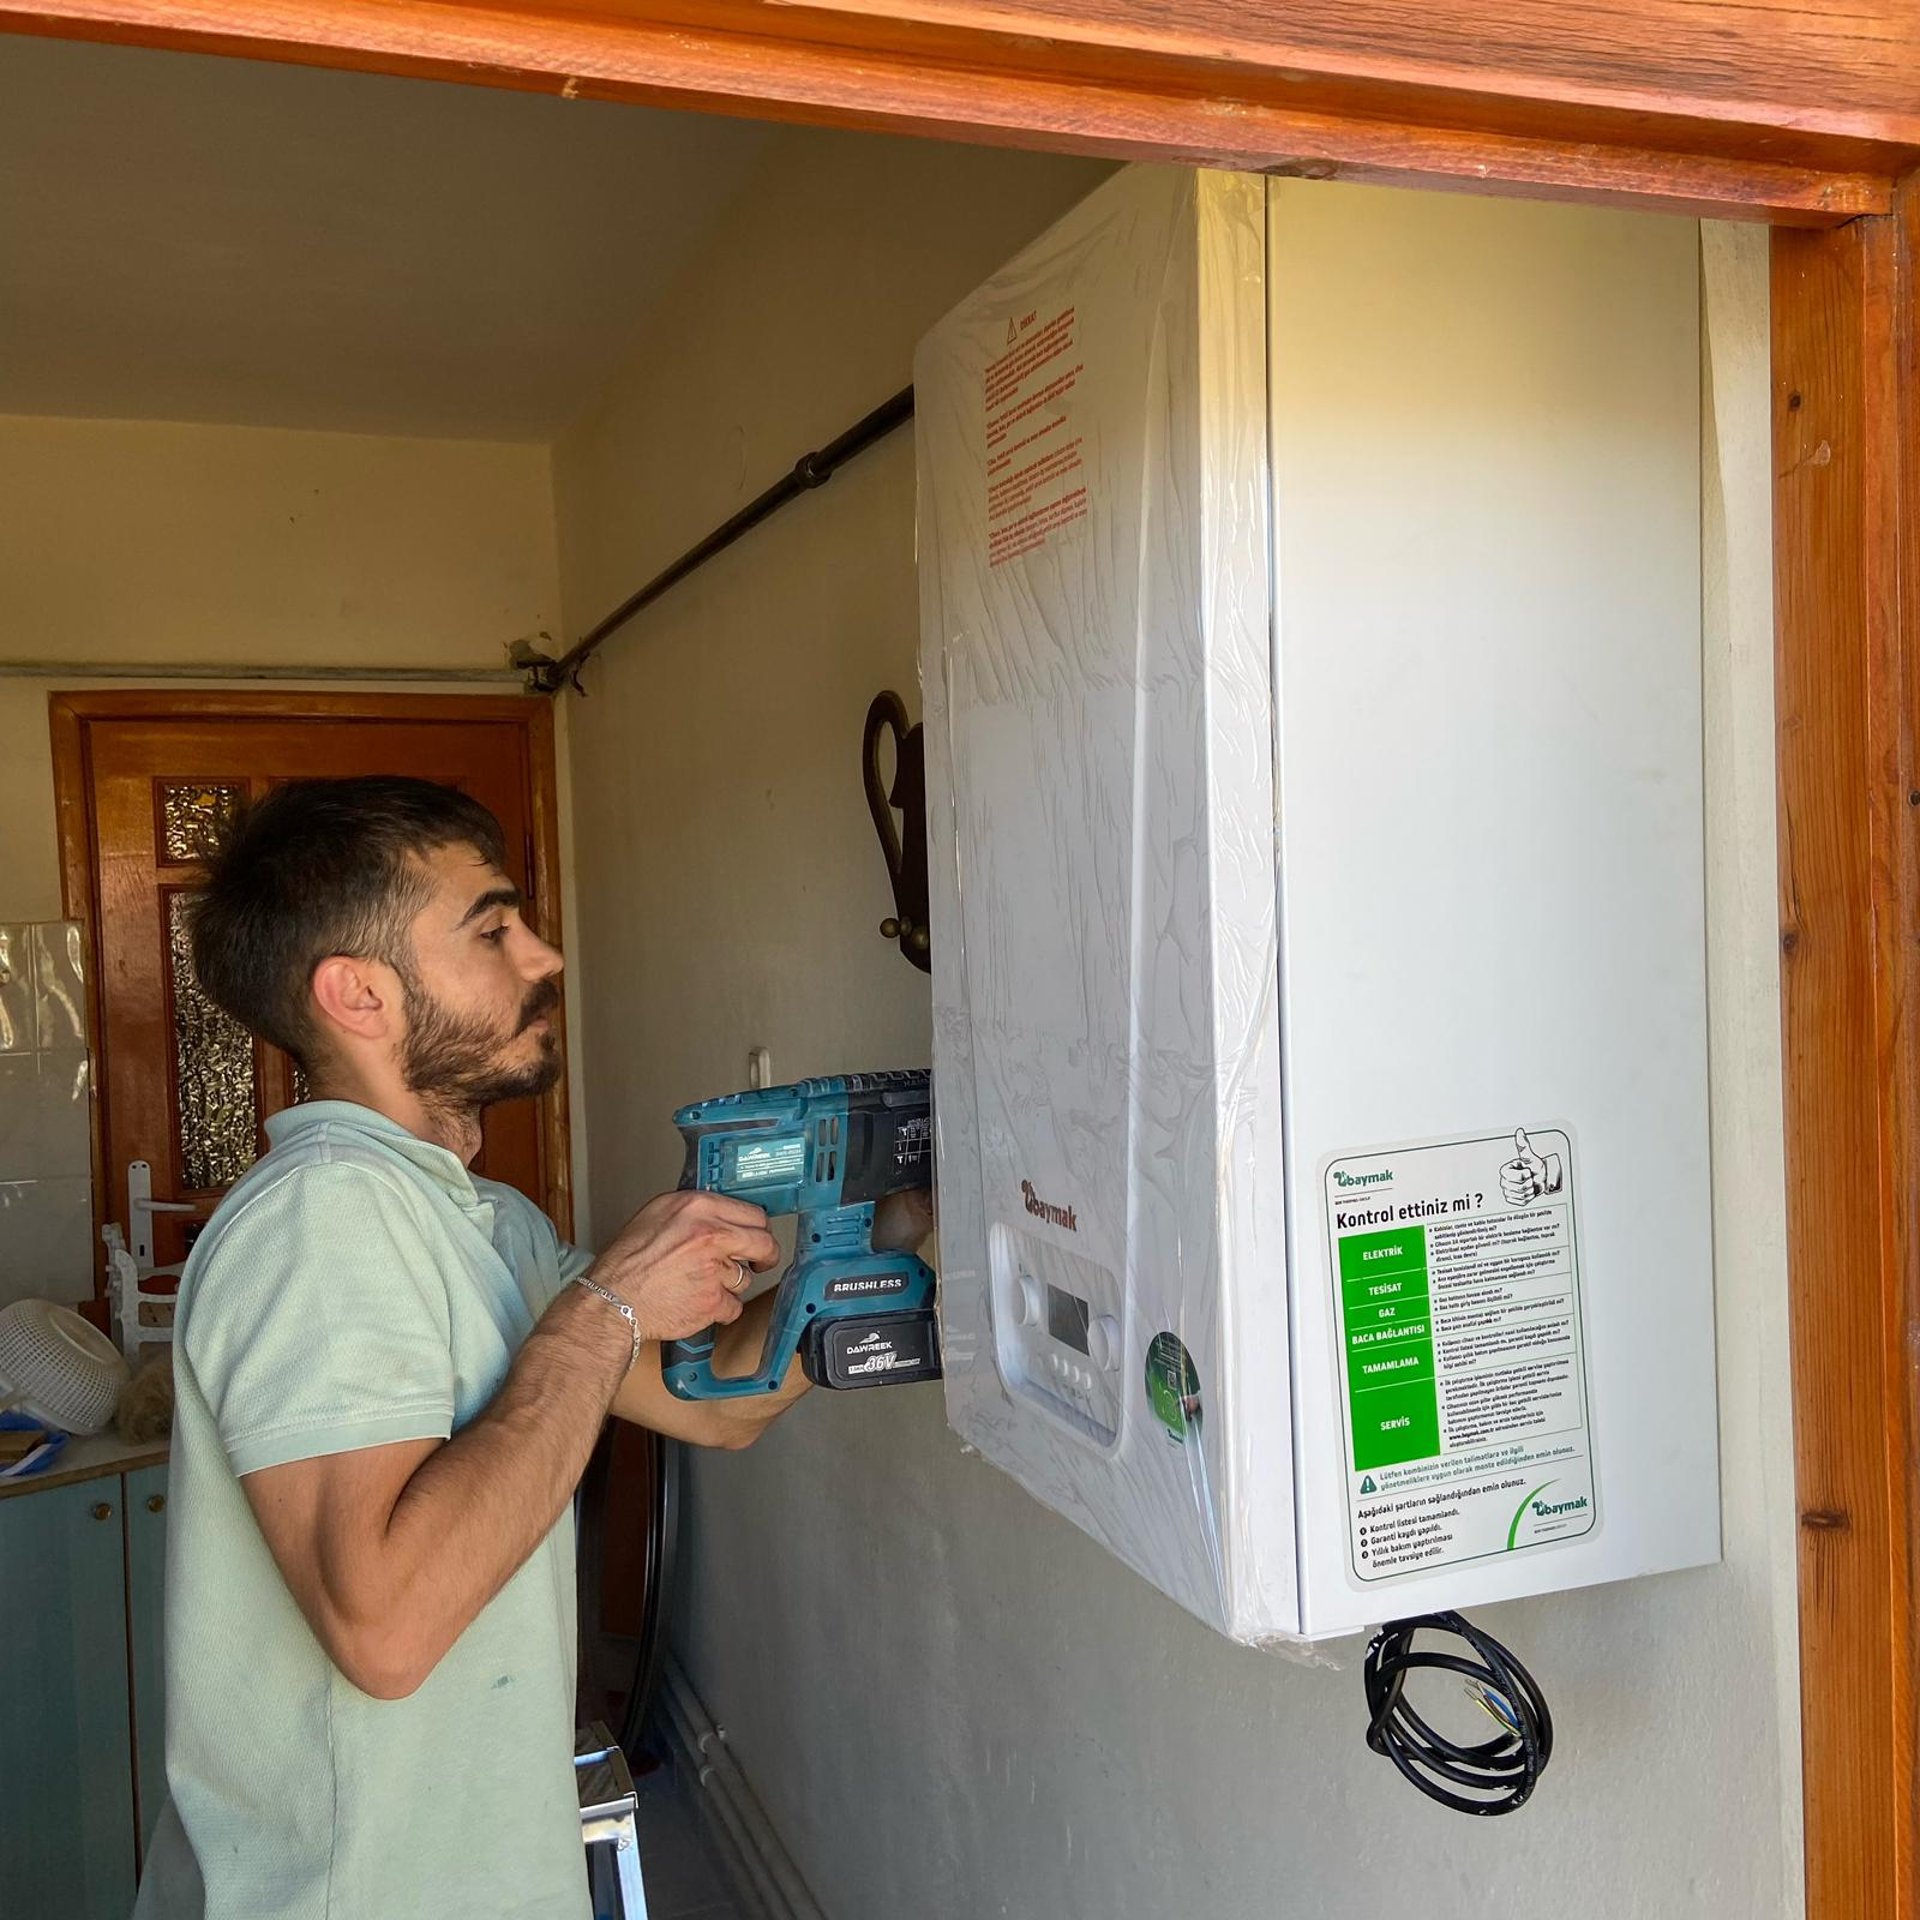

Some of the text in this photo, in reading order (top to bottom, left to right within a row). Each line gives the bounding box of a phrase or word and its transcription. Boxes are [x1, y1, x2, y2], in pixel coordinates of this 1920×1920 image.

[1345, 1169, 1393, 1188] baymak
[1031, 1190, 1077, 1232] baymak
[1336, 1192, 1483, 1229] Kontrol ettiniz mi ?
[1362, 1244, 1403, 1260] ELEKTRİK
[834, 1279, 902, 1292] BRUSHLESS
[1367, 1280, 1402, 1296] TESİSAT
[1378, 1306, 1395, 1317] GAZ
[1351, 1322, 1425, 1344] BACA BAĞLANTISI
[847, 1341, 892, 1354] DAWREEK
[867, 1351, 897, 1372] 36V
[1361, 1356, 1419, 1374] TAMAMLAMA
[1379, 1414, 1410, 1431] SERVİS
[1379, 1445, 1524, 1482] Lütfen kombinizin verilen talimatlara ve ilgili
[1431, 1469, 1451, 1480] uygun
[1452, 1464, 1473, 1476] olarak
[1474, 1460, 1494, 1471] monte
[1535, 1448, 1551, 1458] emin
[1551, 1444, 1575, 1456] olunuz.
[1357, 1475, 1526, 1520] Aşağıdaki şartların sağlandığından emin olunuz.
[1543, 1495, 1587, 1517] baymak
[1369, 1506, 1460, 1533] Kontrol listesi tamamlandı.
[1370, 1522, 1442, 1545] Garanti kaydı yapıldı.
[1371, 1532, 1453, 1557] Yıllık bakım yaptırılması
[1371, 1545, 1444, 1568] önemle tavsiye edilir.
